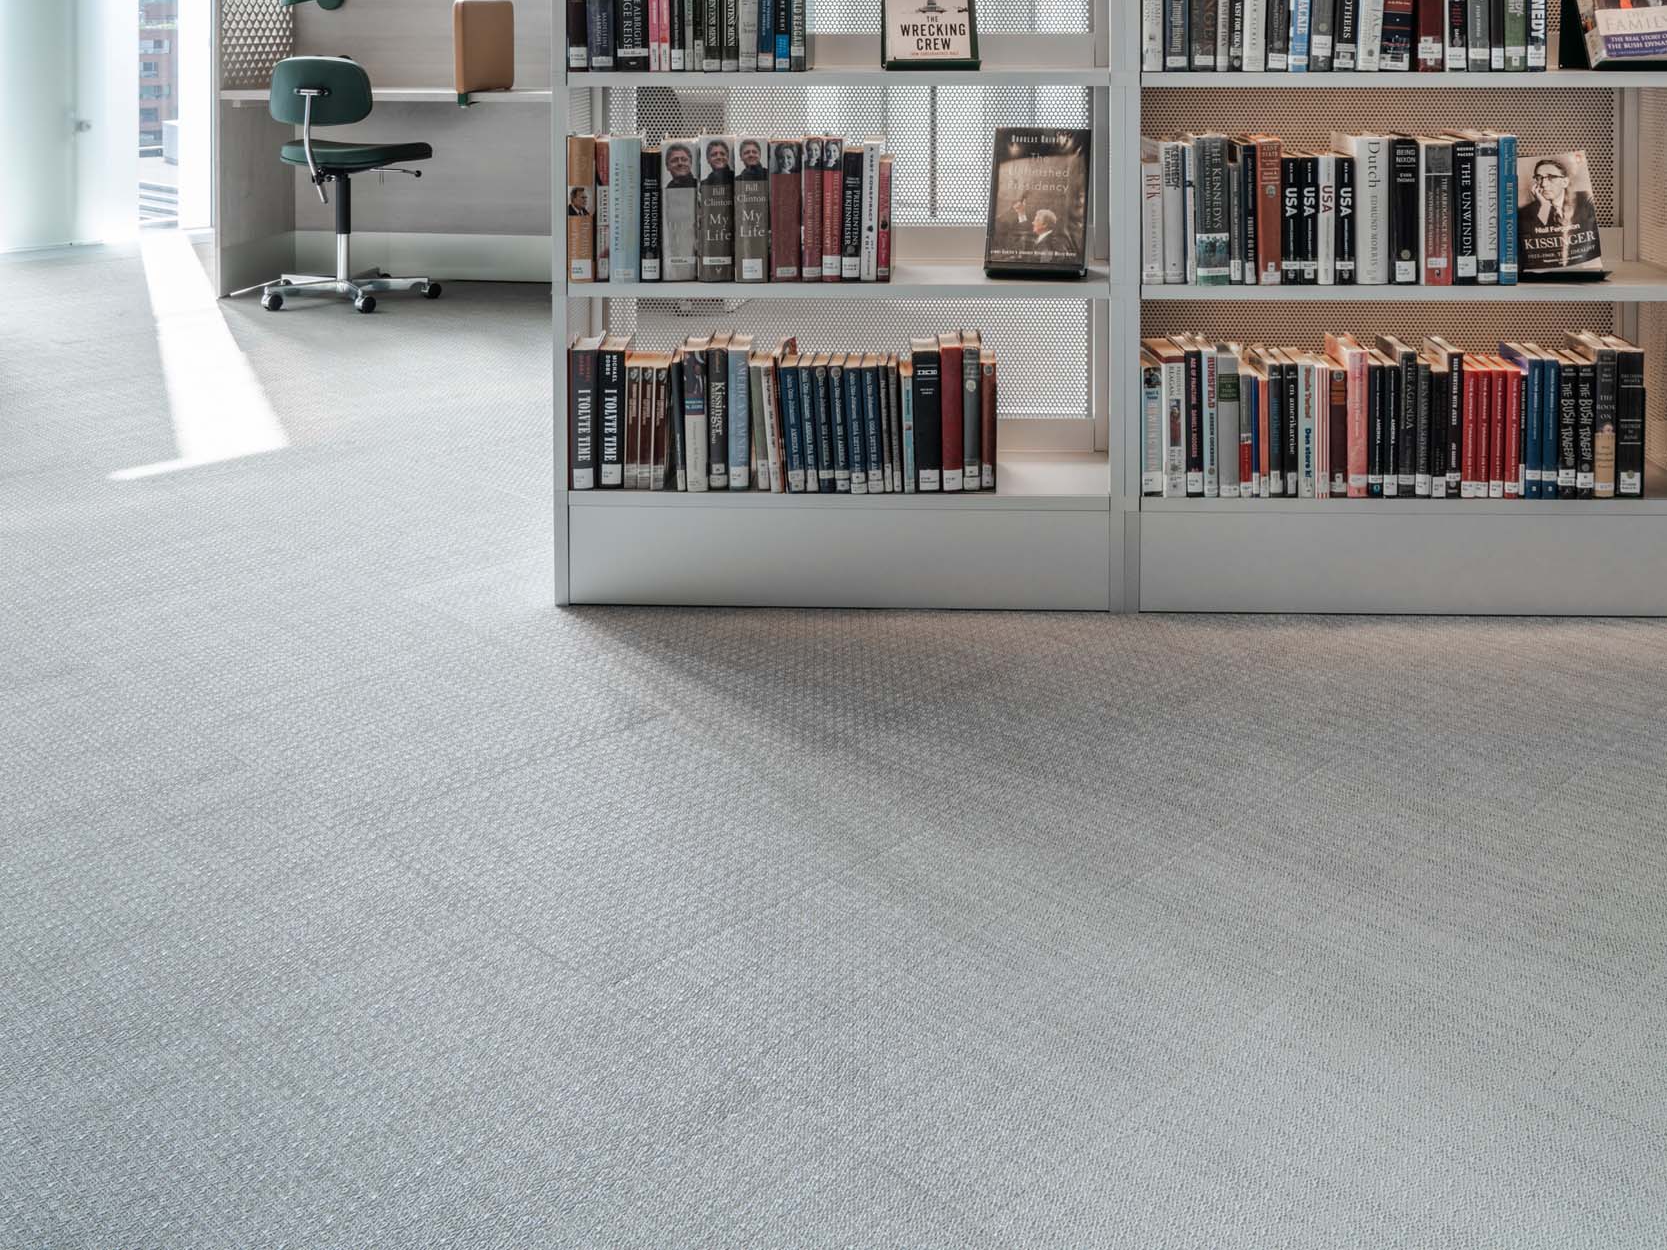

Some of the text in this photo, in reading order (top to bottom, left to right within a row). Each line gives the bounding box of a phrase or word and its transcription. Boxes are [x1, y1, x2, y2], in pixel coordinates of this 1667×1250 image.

[623, 20, 632, 49] REISE
[633, 6, 642, 49] ALBRIGHT
[708, 26, 717, 47] MENN
[727, 26, 736, 47] MENN
[793, 15, 803, 47] REAGAN
[900, 24, 966, 36] WRECKING
[1170, 28, 1183, 53] History
[916, 38, 951, 50] CREW
[1368, 141, 1381, 188] Dutch
[712, 187, 725, 196] Bill
[737, 195, 765, 203] Clinton
[745, 183, 758, 191] Bill
[1007, 181, 1069, 193] Presidency
[1146, 174, 1160, 200] RFK
[1212, 141, 1223, 229] THE KENNEDYS
[1322, 185, 1333, 213] USA
[704, 198, 732, 206] Clinton
[1284, 187, 1297, 216] USA
[1304, 187, 1315, 216] USA
[1340, 187, 1352, 216] USA
[1462, 162, 1472, 256] THE UNWINDIN
[1488, 164, 1496, 252] RESTLESS GIANT
[651, 191, 659, 248] PRESIDENTENS
[710, 214, 728, 227] My
[743, 210, 762, 223] My
[852, 190, 860, 246] PRESIDENTENS
[706, 229, 731, 241] Life
[740, 225, 765, 237] Life
[1524, 230, 1596, 250] KISSINGER
[711, 382, 726, 436] Kissinger
[1406, 361, 1415, 429] THE AGENDA
[578, 396, 590, 434] TOLVTE
[604, 396, 617, 434] TOLVTE
[1561, 383, 1576, 461] THE BUSH TRAGEDY
[1579, 383, 1594, 461] THE BUSH TRAGEDY
[578, 436, 590, 461] TIME
[604, 436, 617, 461] TIME
[737, 422, 745, 462] AMNESI
[1304, 428, 1312, 444] Den
